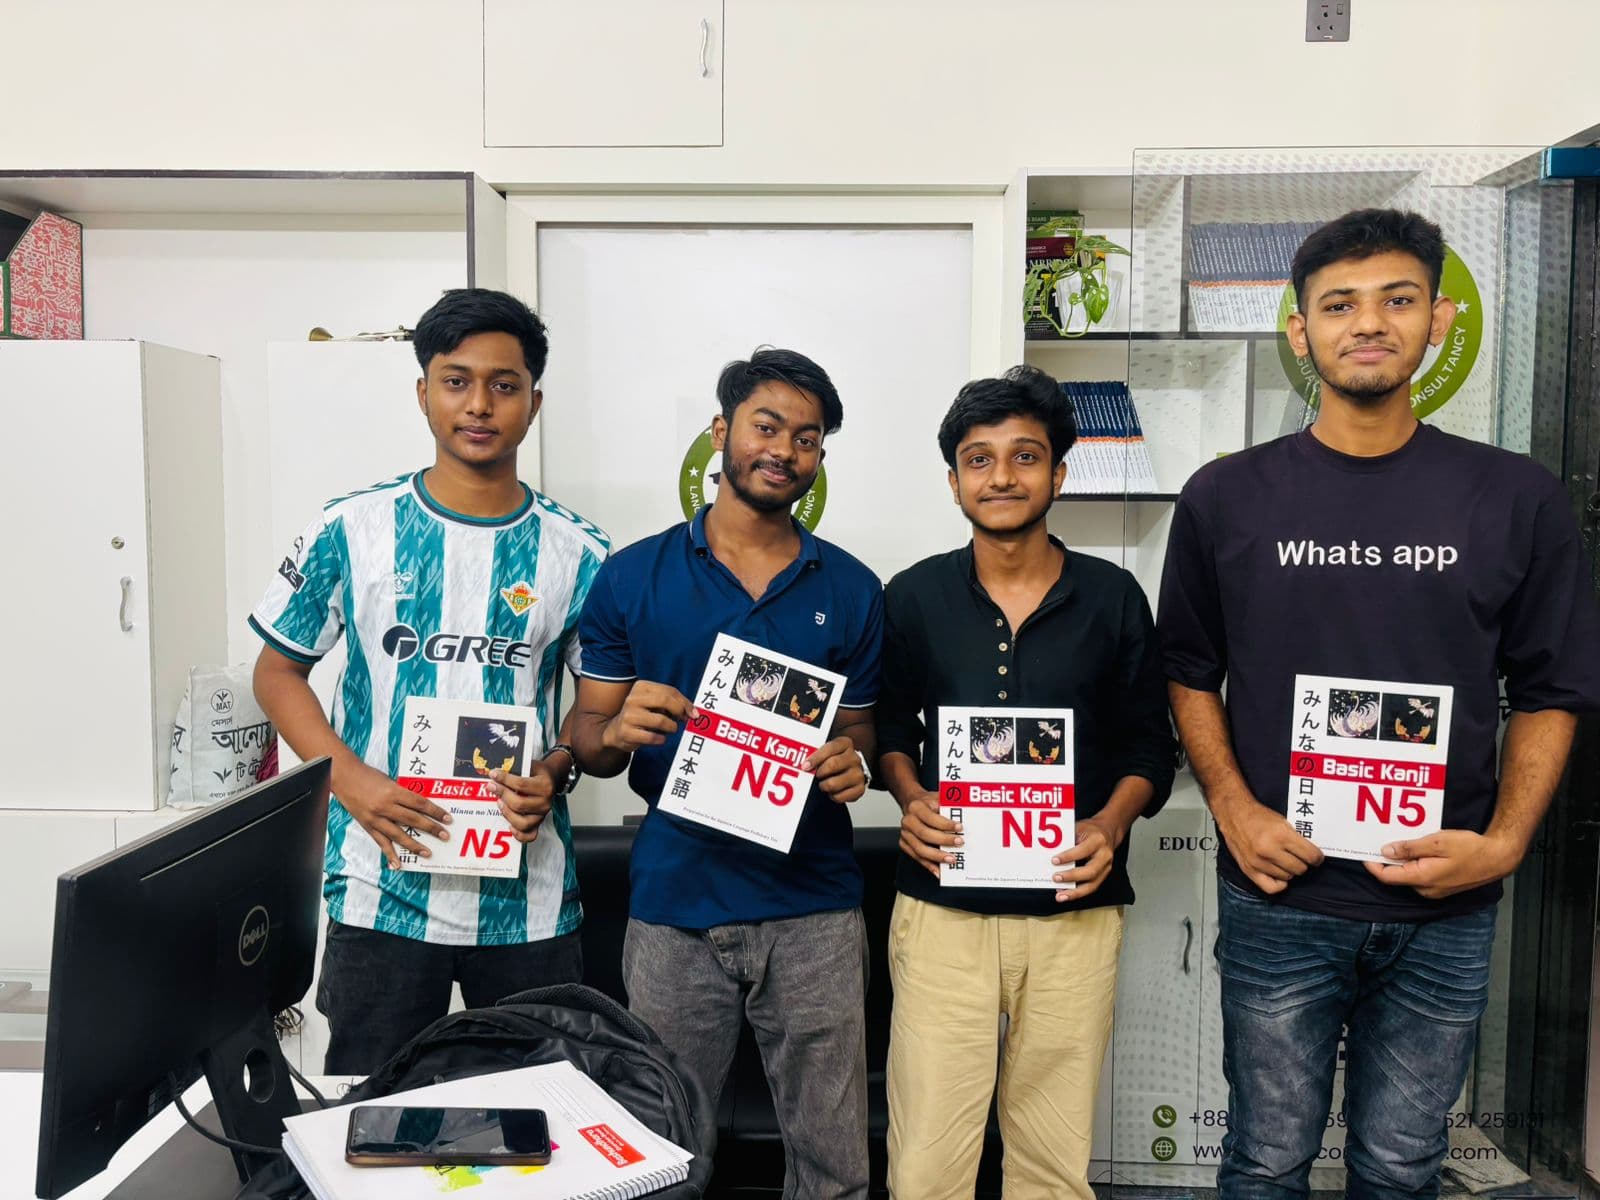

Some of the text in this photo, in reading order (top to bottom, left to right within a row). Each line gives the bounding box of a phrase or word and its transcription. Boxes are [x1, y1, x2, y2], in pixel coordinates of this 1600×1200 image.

[800, 488, 817, 526] TANCY
[1277, 540, 1458, 572] Whats app
[424, 633, 532, 668] GREE
[216, 701, 231, 711] MAT
[670, 648, 735, 799] みんなの日本語
[715, 719, 809, 769] Basic Kanji
[731, 753, 800, 807] N5
[1295, 690, 1321, 838] みんなの日本語
[1322, 757, 1431, 787] Basic Kanji
[430, 780, 473, 797] Basic
[946, 720, 965, 870] みんなの日語
[969, 786, 1063, 809] Basic Kanji
[450, 807, 474, 816] Minna
[1356, 785, 1426, 828] N5
[459, 828, 513, 862] N5
[1002, 810, 1063, 849] N5
[243, 922, 266, 949] DELL
[1445, 1147, 1497, 1160] .com
